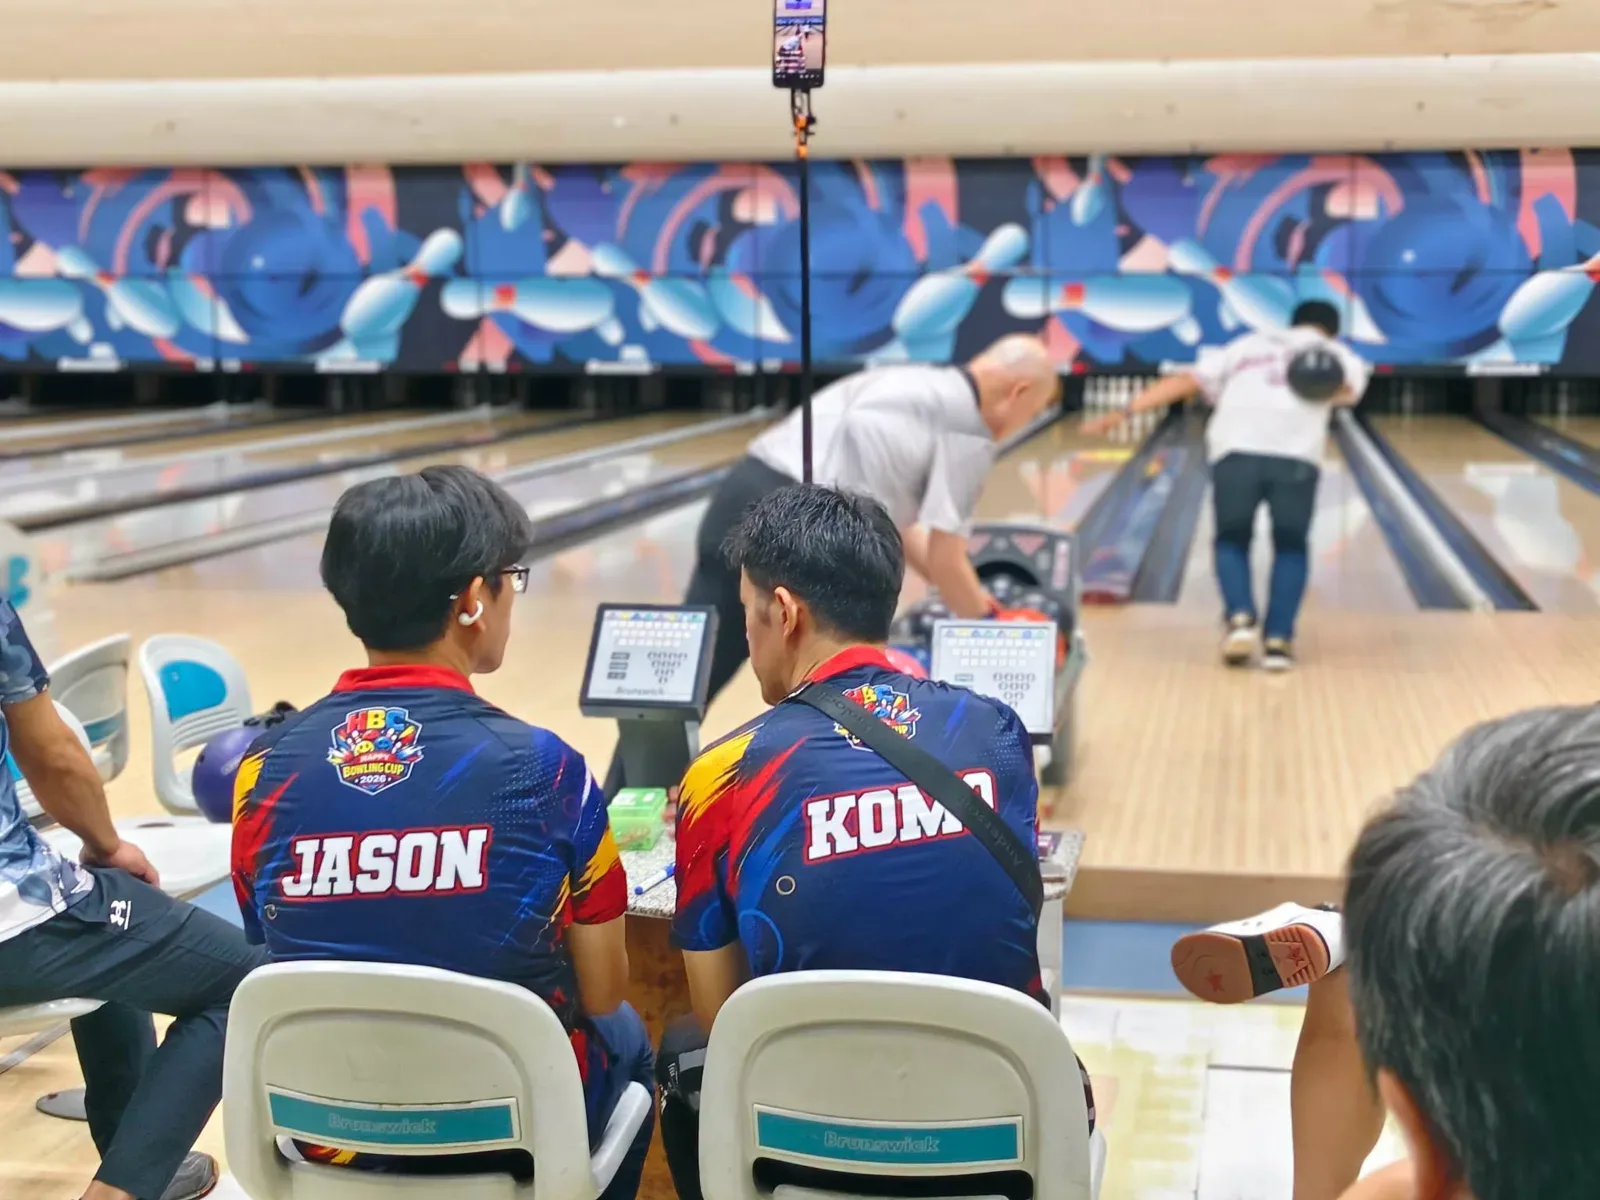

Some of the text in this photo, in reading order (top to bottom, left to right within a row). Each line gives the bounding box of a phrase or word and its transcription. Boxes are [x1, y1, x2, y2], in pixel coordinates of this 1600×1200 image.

[347, 709, 404, 733] HBC
[359, 752, 389, 763] HAPPY
[343, 762, 404, 778] BOWLING CUP
[280, 828, 488, 897] JASON
[328, 1112, 437, 1134] Brunswick
[824, 1130, 940, 1153] Brunswick
